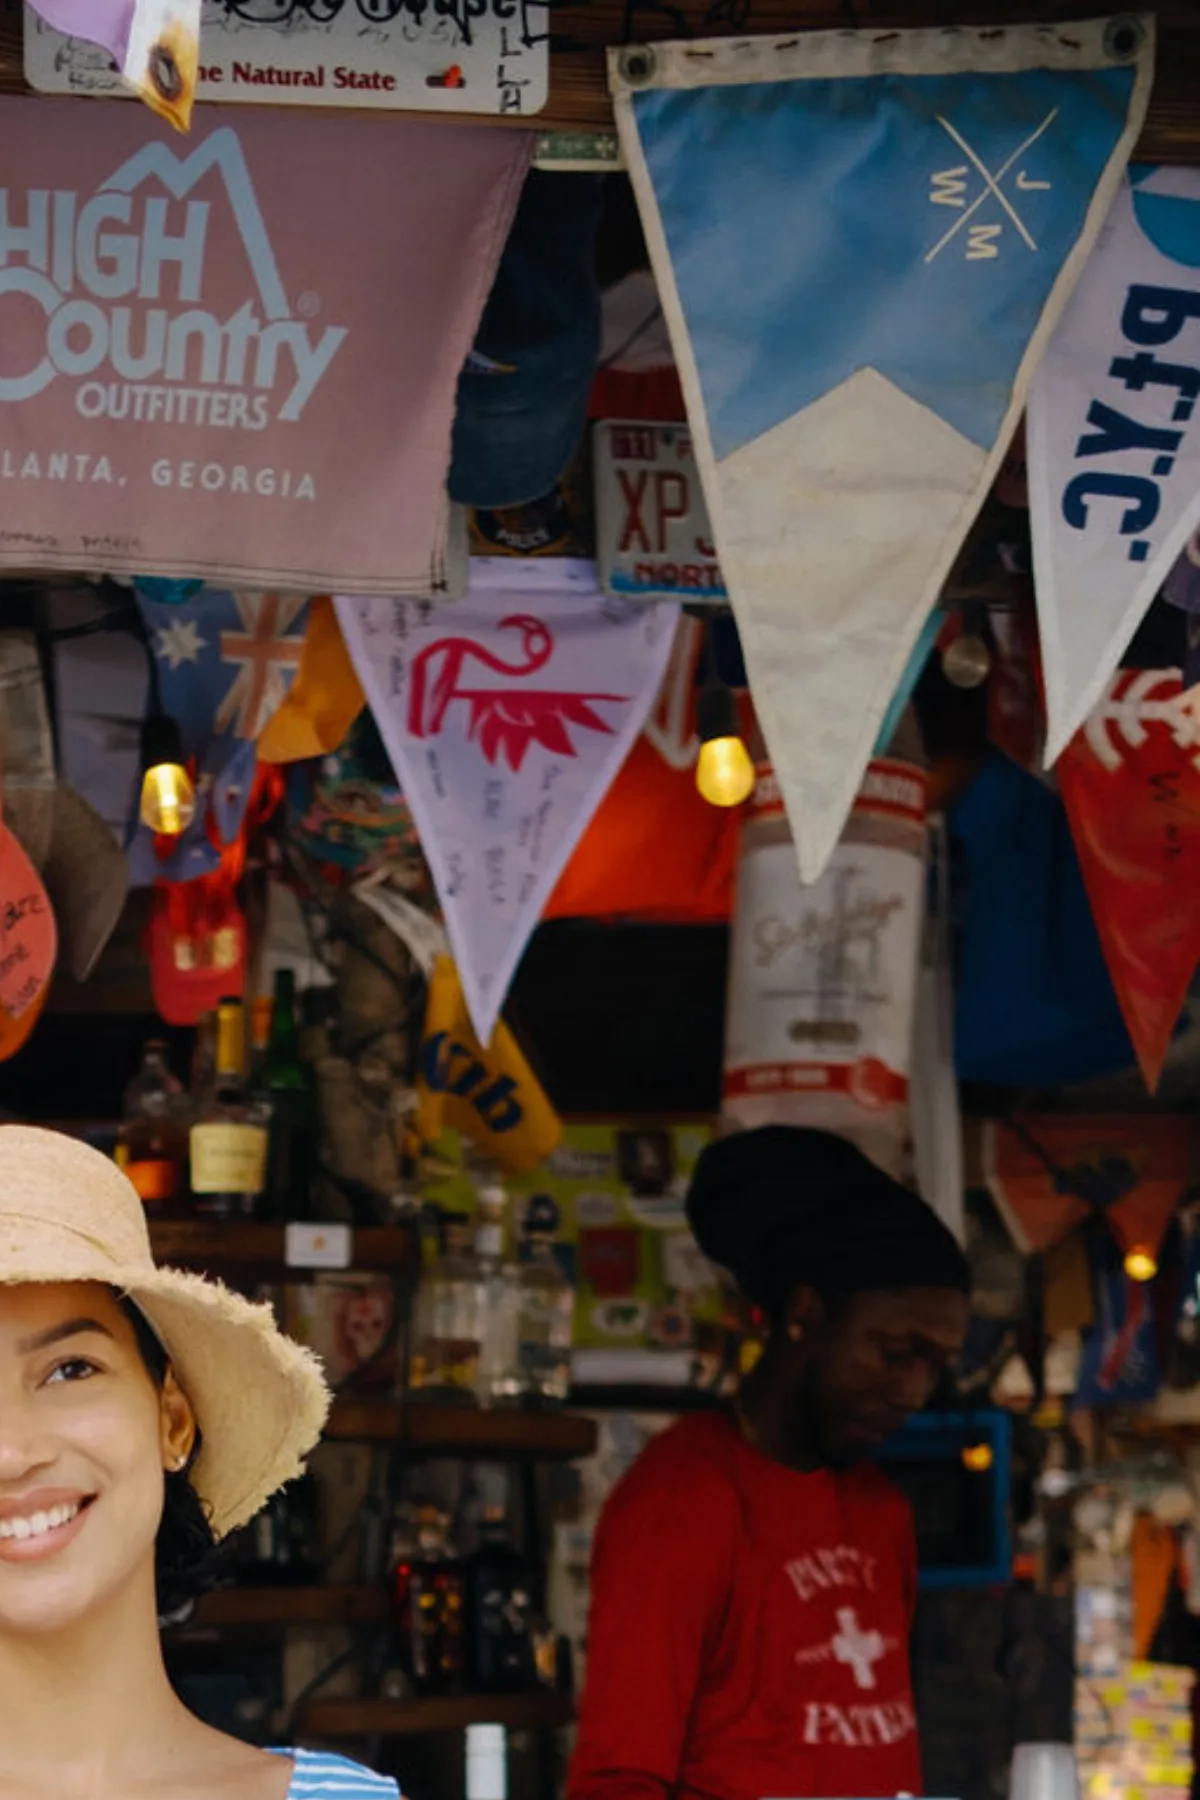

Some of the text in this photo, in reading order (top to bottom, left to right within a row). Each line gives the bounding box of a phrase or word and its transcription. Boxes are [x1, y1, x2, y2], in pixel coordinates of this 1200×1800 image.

[231, 64, 326, 88] Natural
[332, 66, 398, 92] State
[75, 382, 268, 431] OUTFITTERS
[151, 456, 317, 501] GEORGIA
[615, 467, 689, 554] XP
[632, 561, 721, 589] NORT
